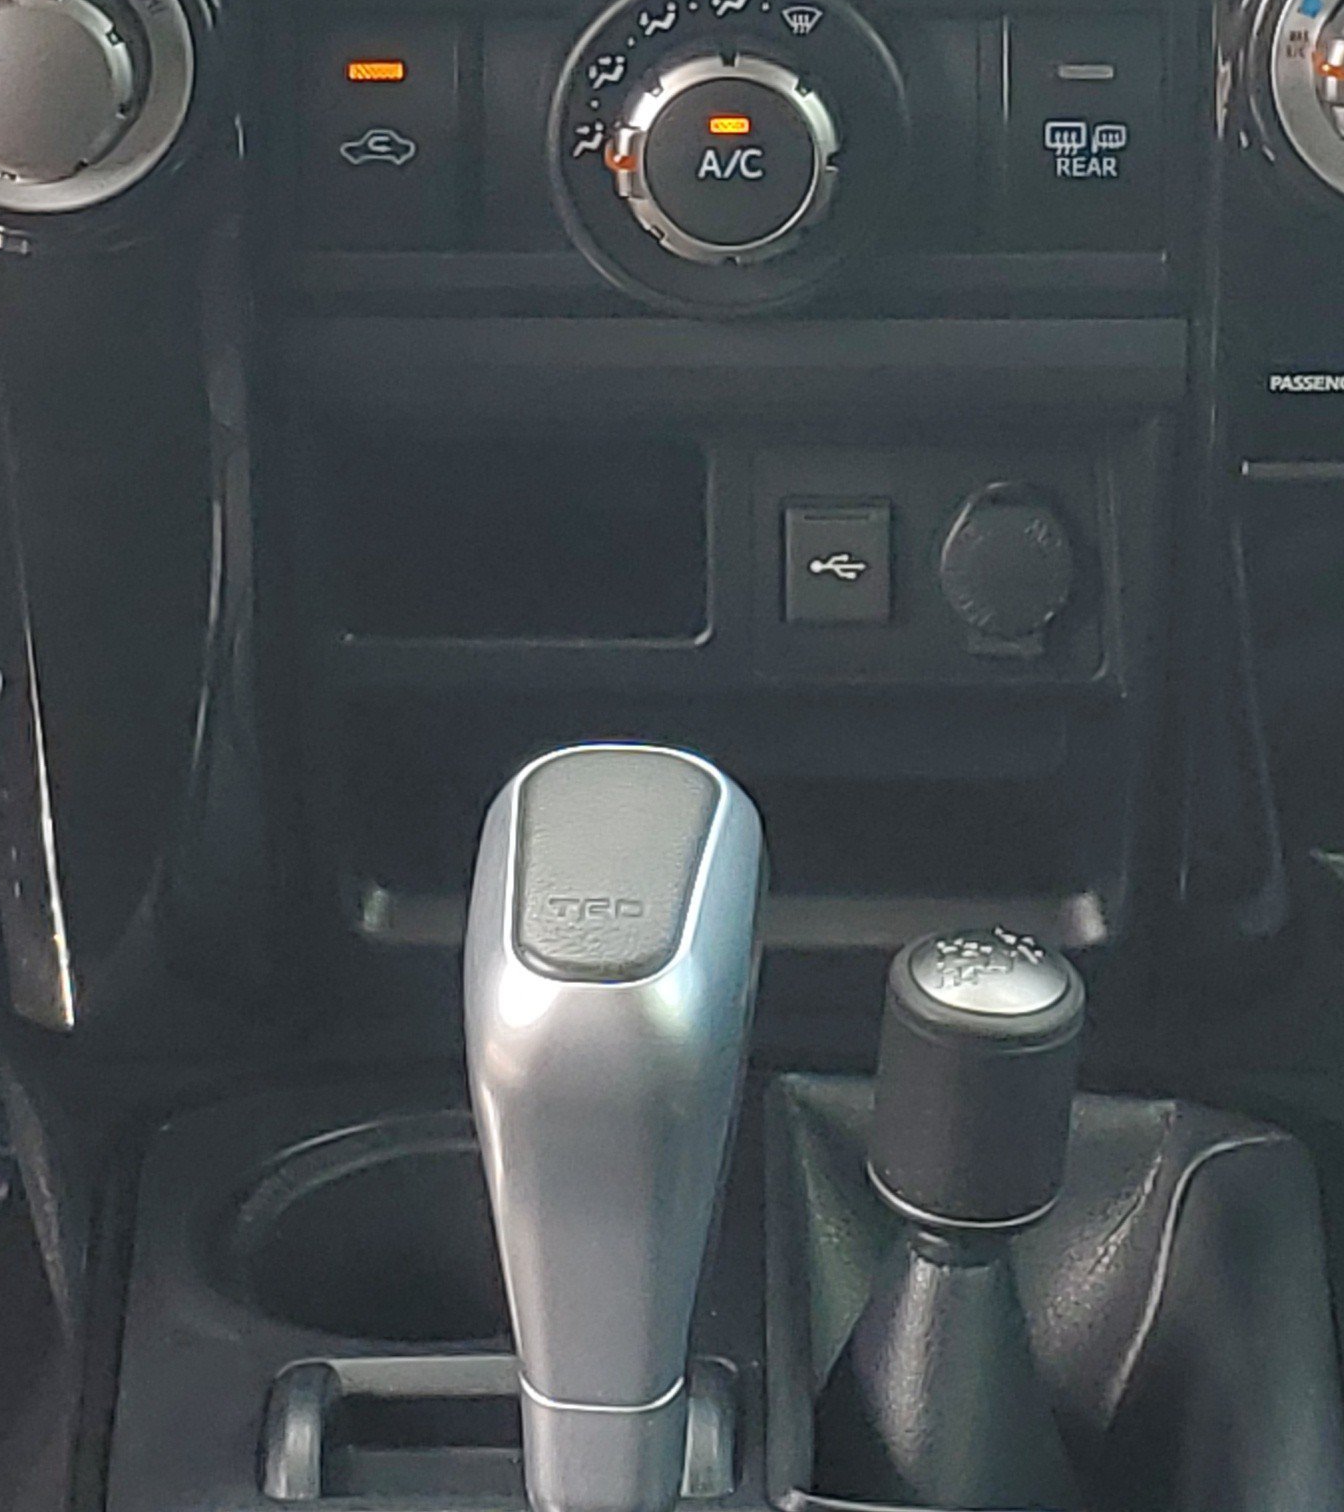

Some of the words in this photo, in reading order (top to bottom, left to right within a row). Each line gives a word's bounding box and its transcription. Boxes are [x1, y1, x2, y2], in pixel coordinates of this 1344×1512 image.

[697, 148, 764, 179] A/C
[1055, 157, 1118, 178] REAR
[548, 897, 644, 923] TRD
